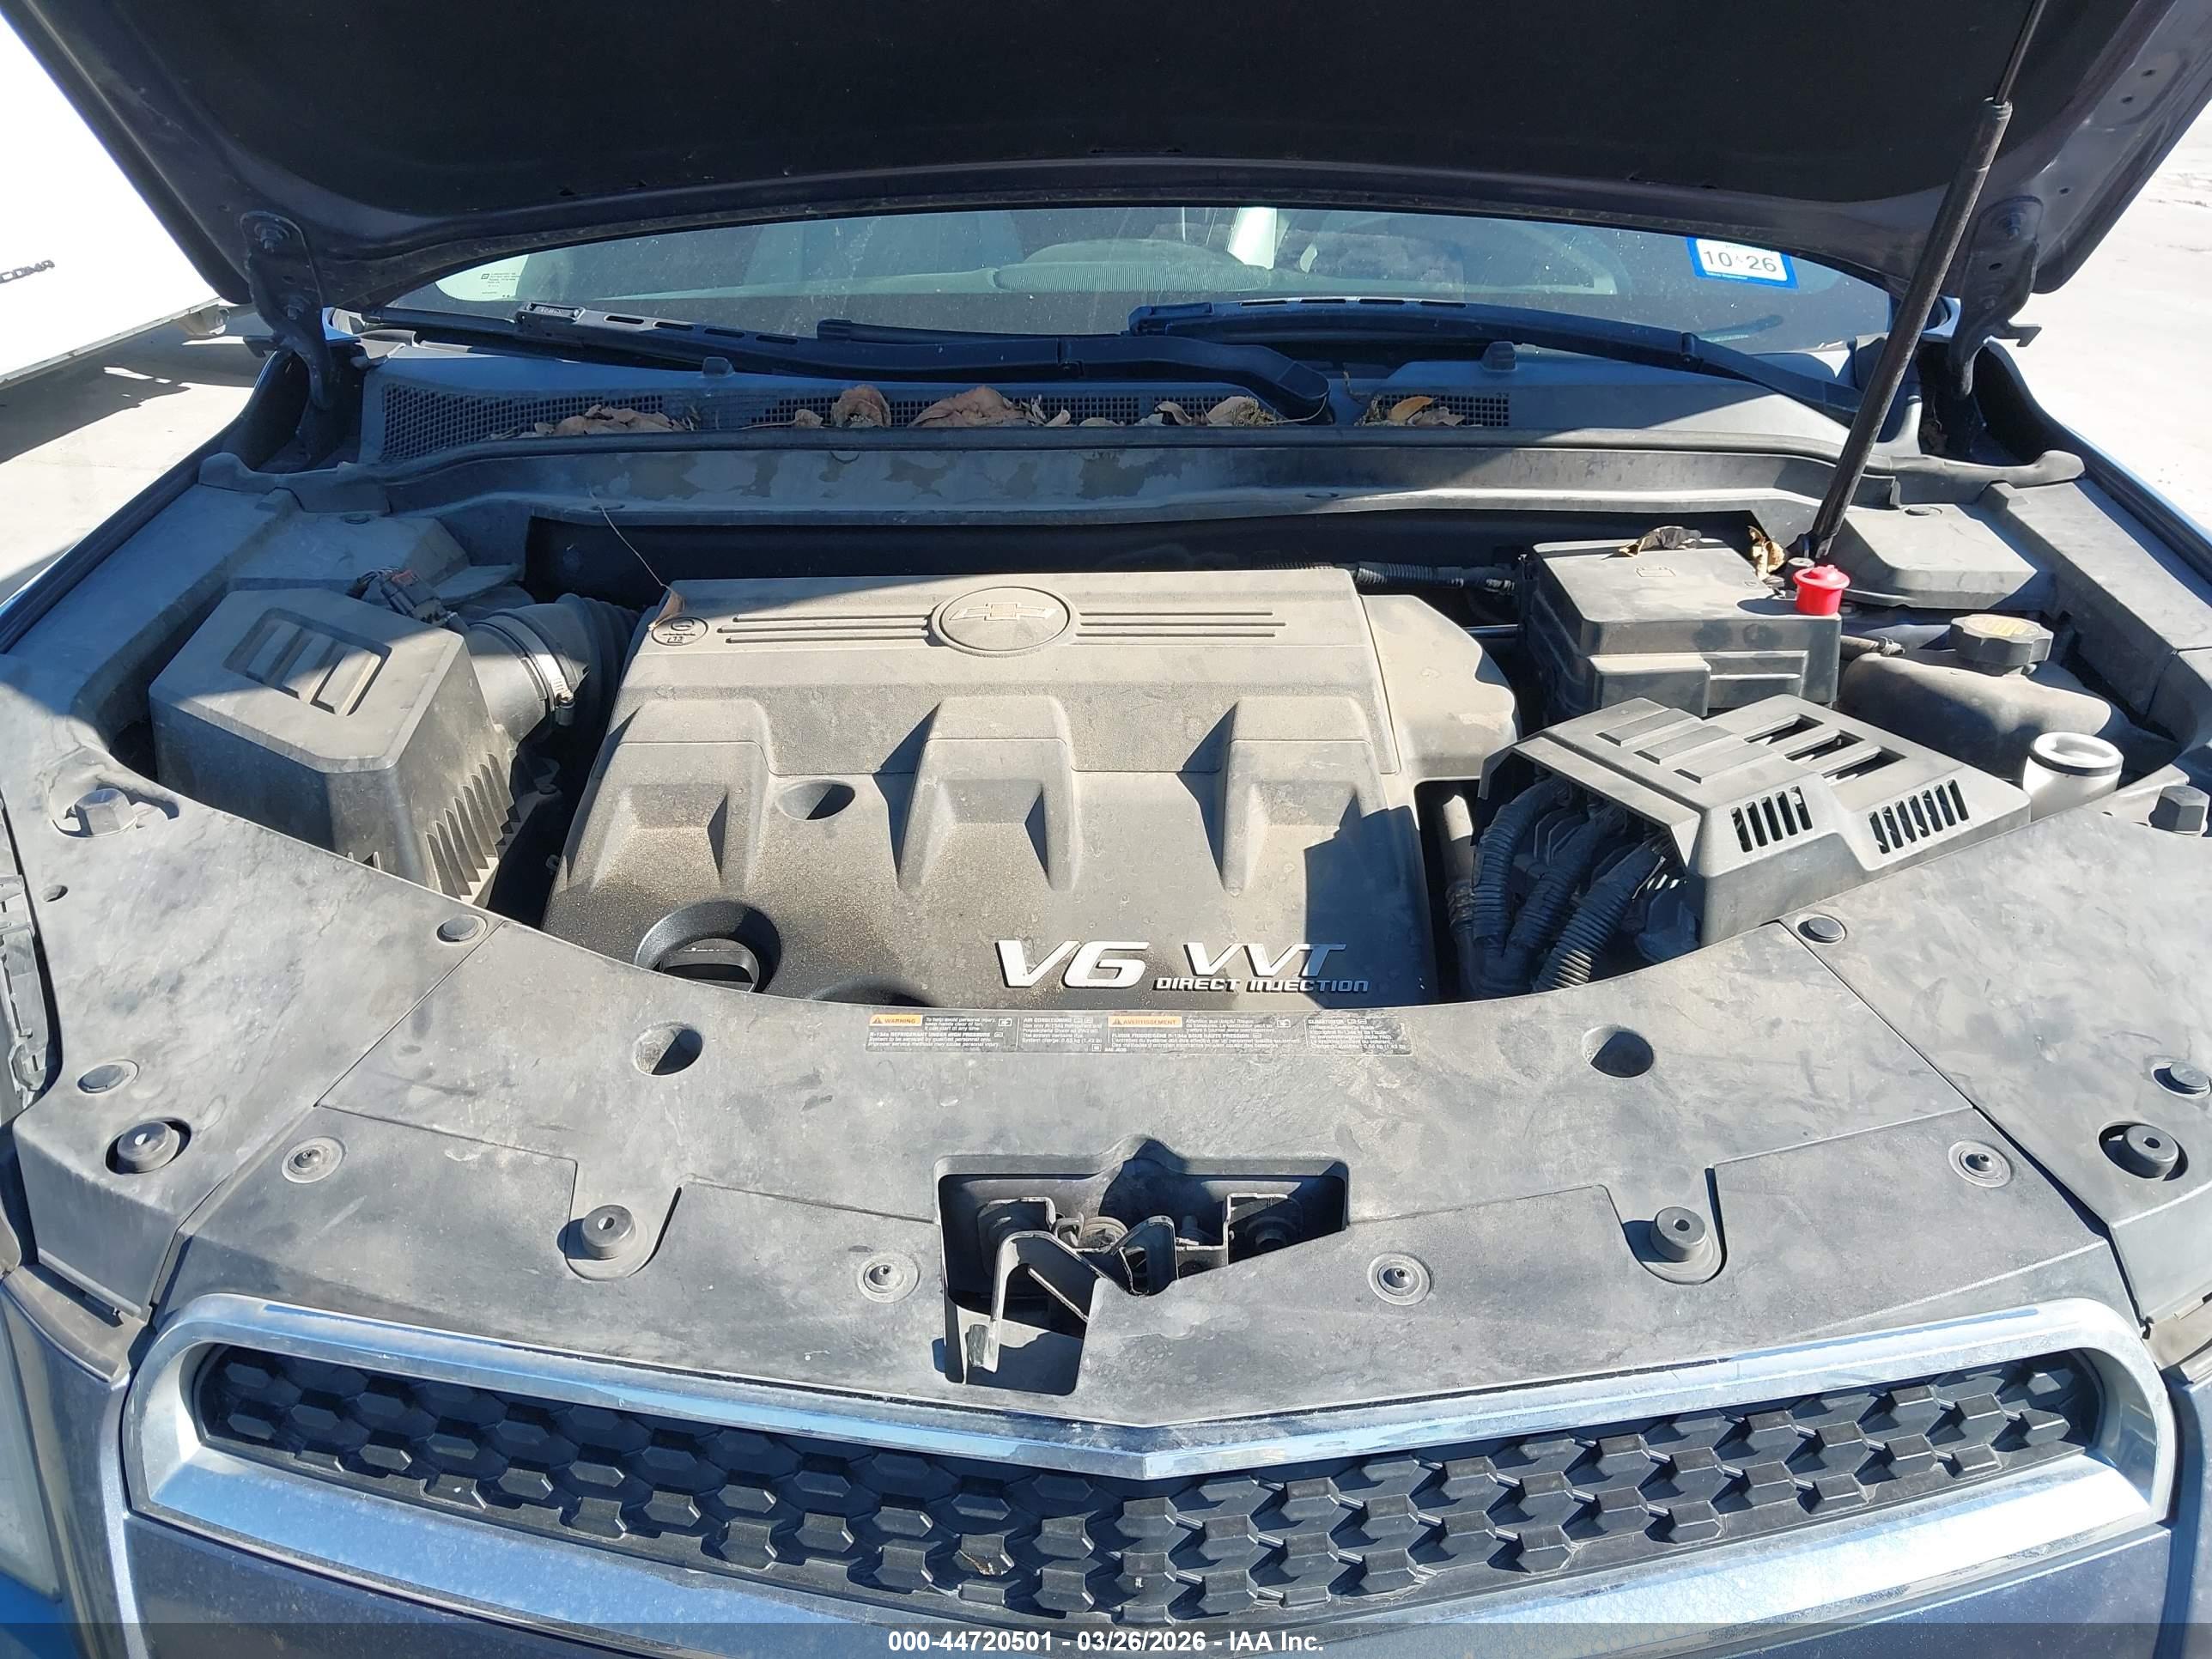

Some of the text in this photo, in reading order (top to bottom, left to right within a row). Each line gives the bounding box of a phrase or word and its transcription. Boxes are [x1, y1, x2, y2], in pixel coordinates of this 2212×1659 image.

[1704, 251, 1777, 272] 10 26
[995, 939, 1347, 989] V6 VVT
[1152, 977, 1371, 993] DIRECT INJECTION
